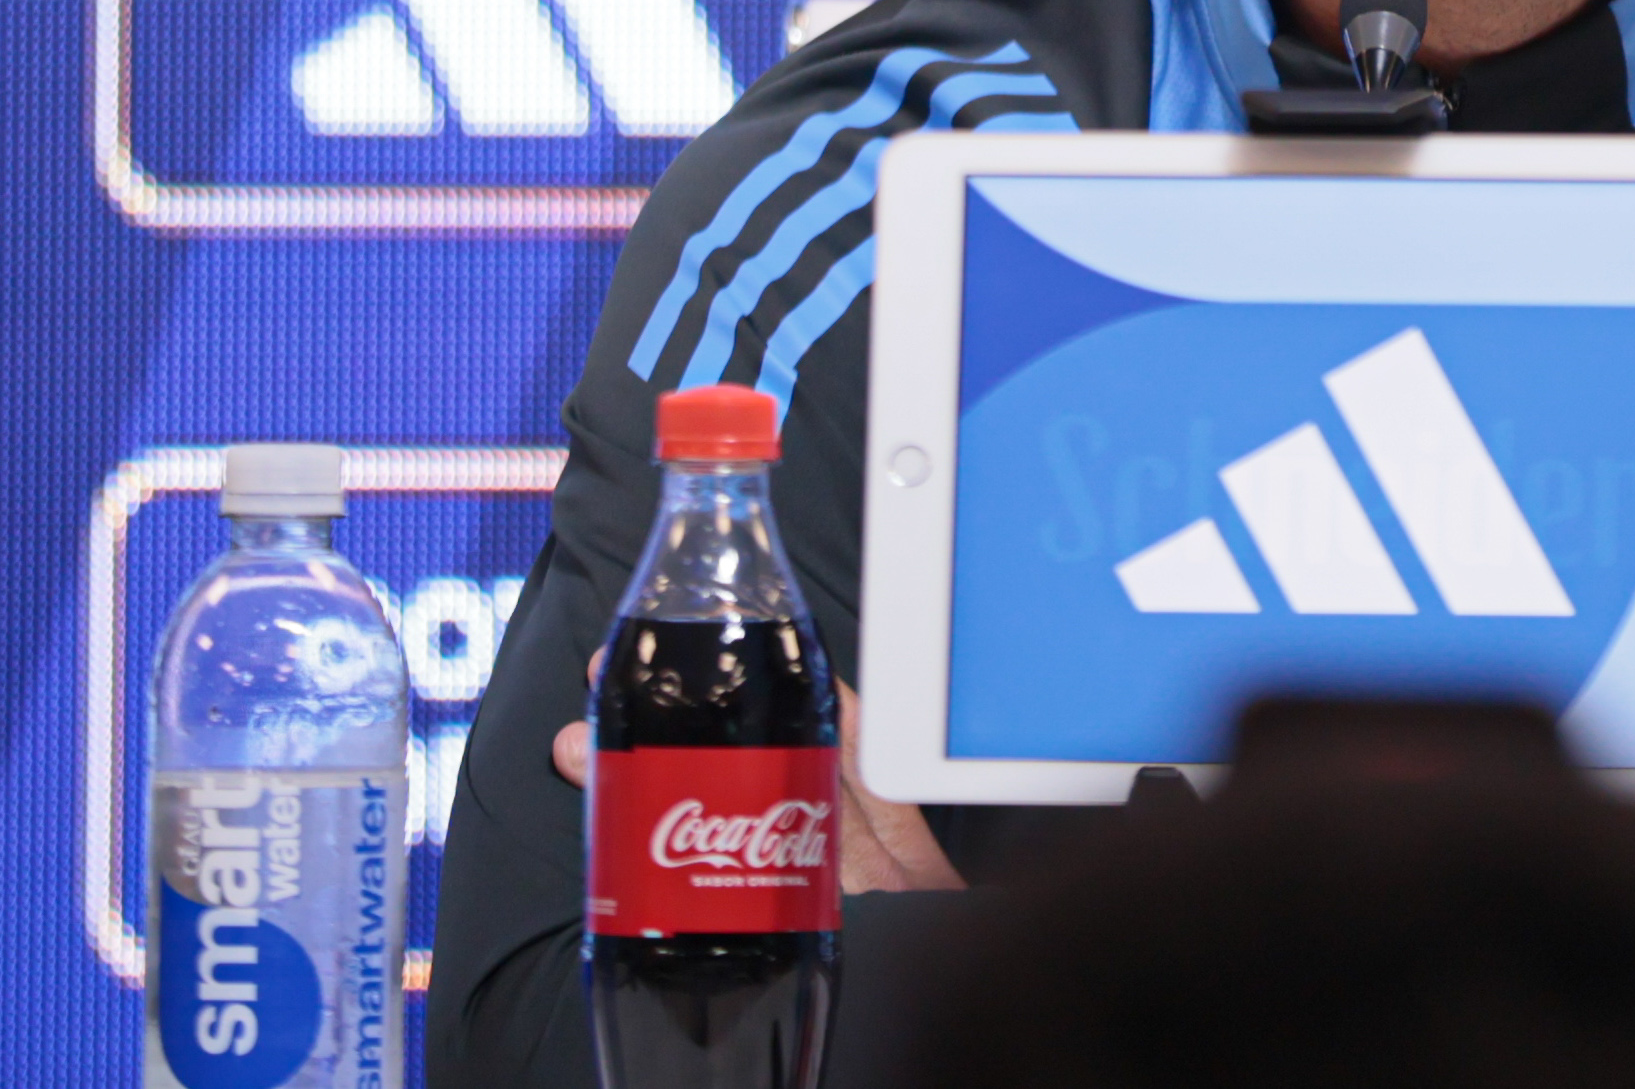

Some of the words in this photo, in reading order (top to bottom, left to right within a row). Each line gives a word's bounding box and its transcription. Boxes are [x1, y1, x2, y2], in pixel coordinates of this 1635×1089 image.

[190, 772, 262, 1057] smart
[263, 777, 302, 903] water
[354, 777, 387, 1089] smartwater
[651, 798, 831, 869] Coca-Cola
